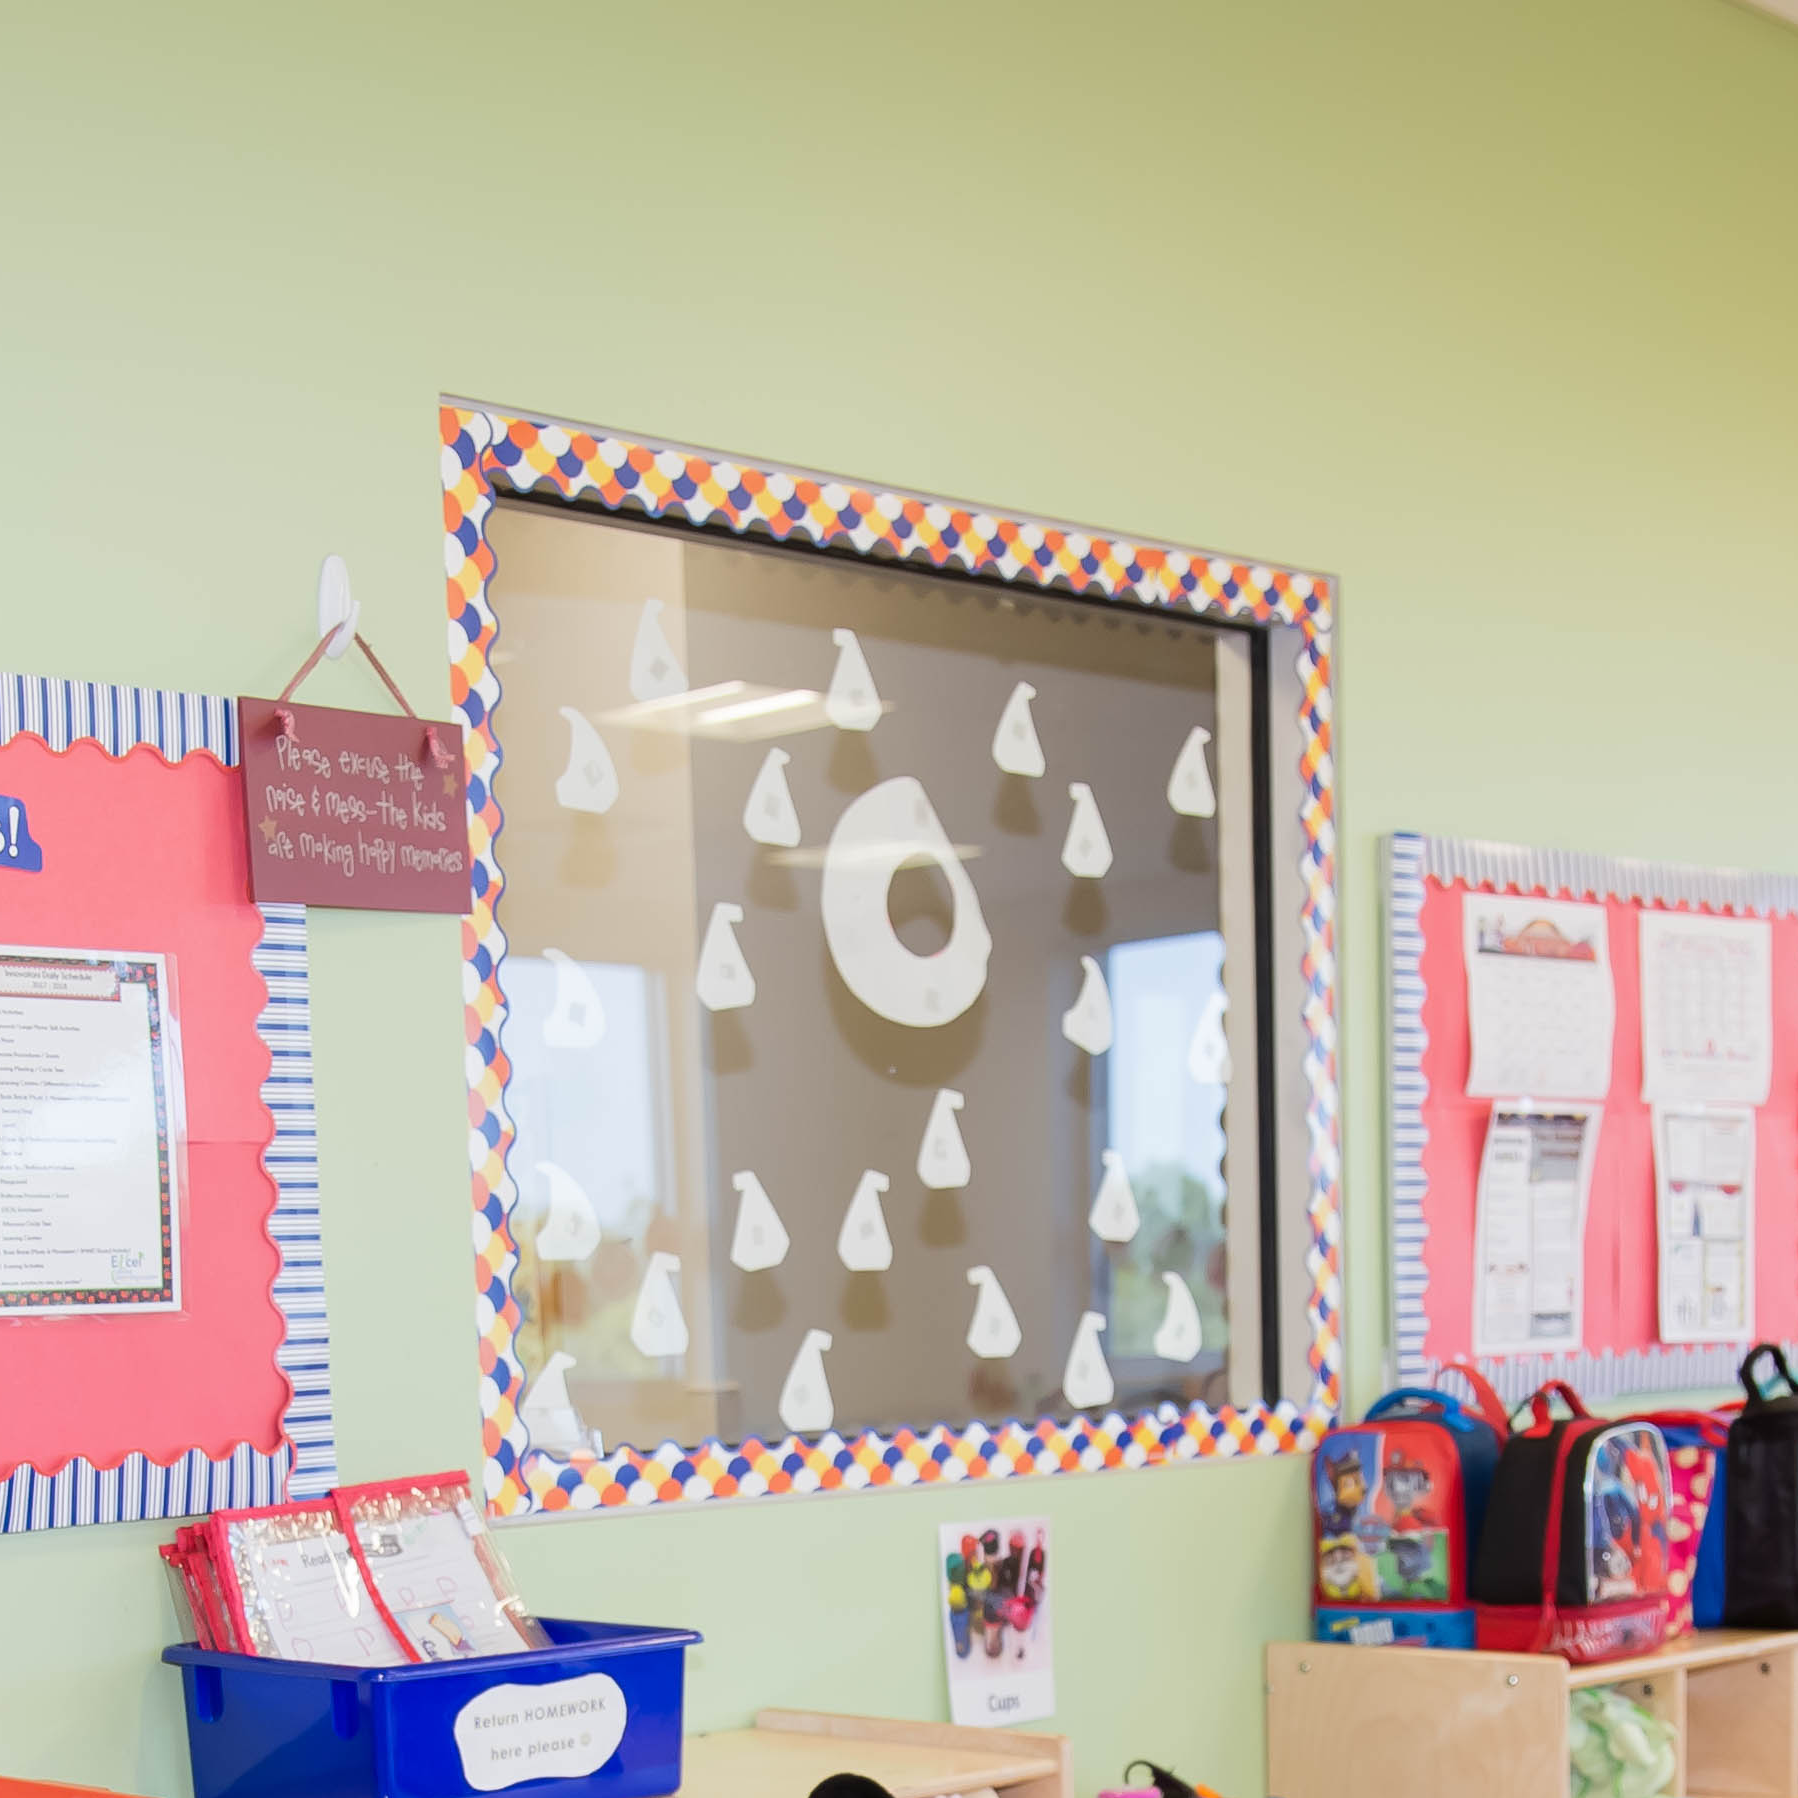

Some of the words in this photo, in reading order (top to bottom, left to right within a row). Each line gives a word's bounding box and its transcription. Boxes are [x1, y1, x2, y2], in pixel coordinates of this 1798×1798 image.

[275, 735, 332, 778] Please
[338, 750, 390, 784] excuse
[395, 753, 424, 791] the
[265, 783, 306, 817] noise
[311, 785, 320, 816] &
[412, 792, 446, 832] kids
[358, 830, 396, 874] happy
[473, 1711, 520, 1731] Return
[523, 1697, 607, 1723] HOMEWORK
[988, 1692, 1020, 1713] Cups
[490, 1742, 523, 1762] here
[527, 1735, 576, 1758] please
